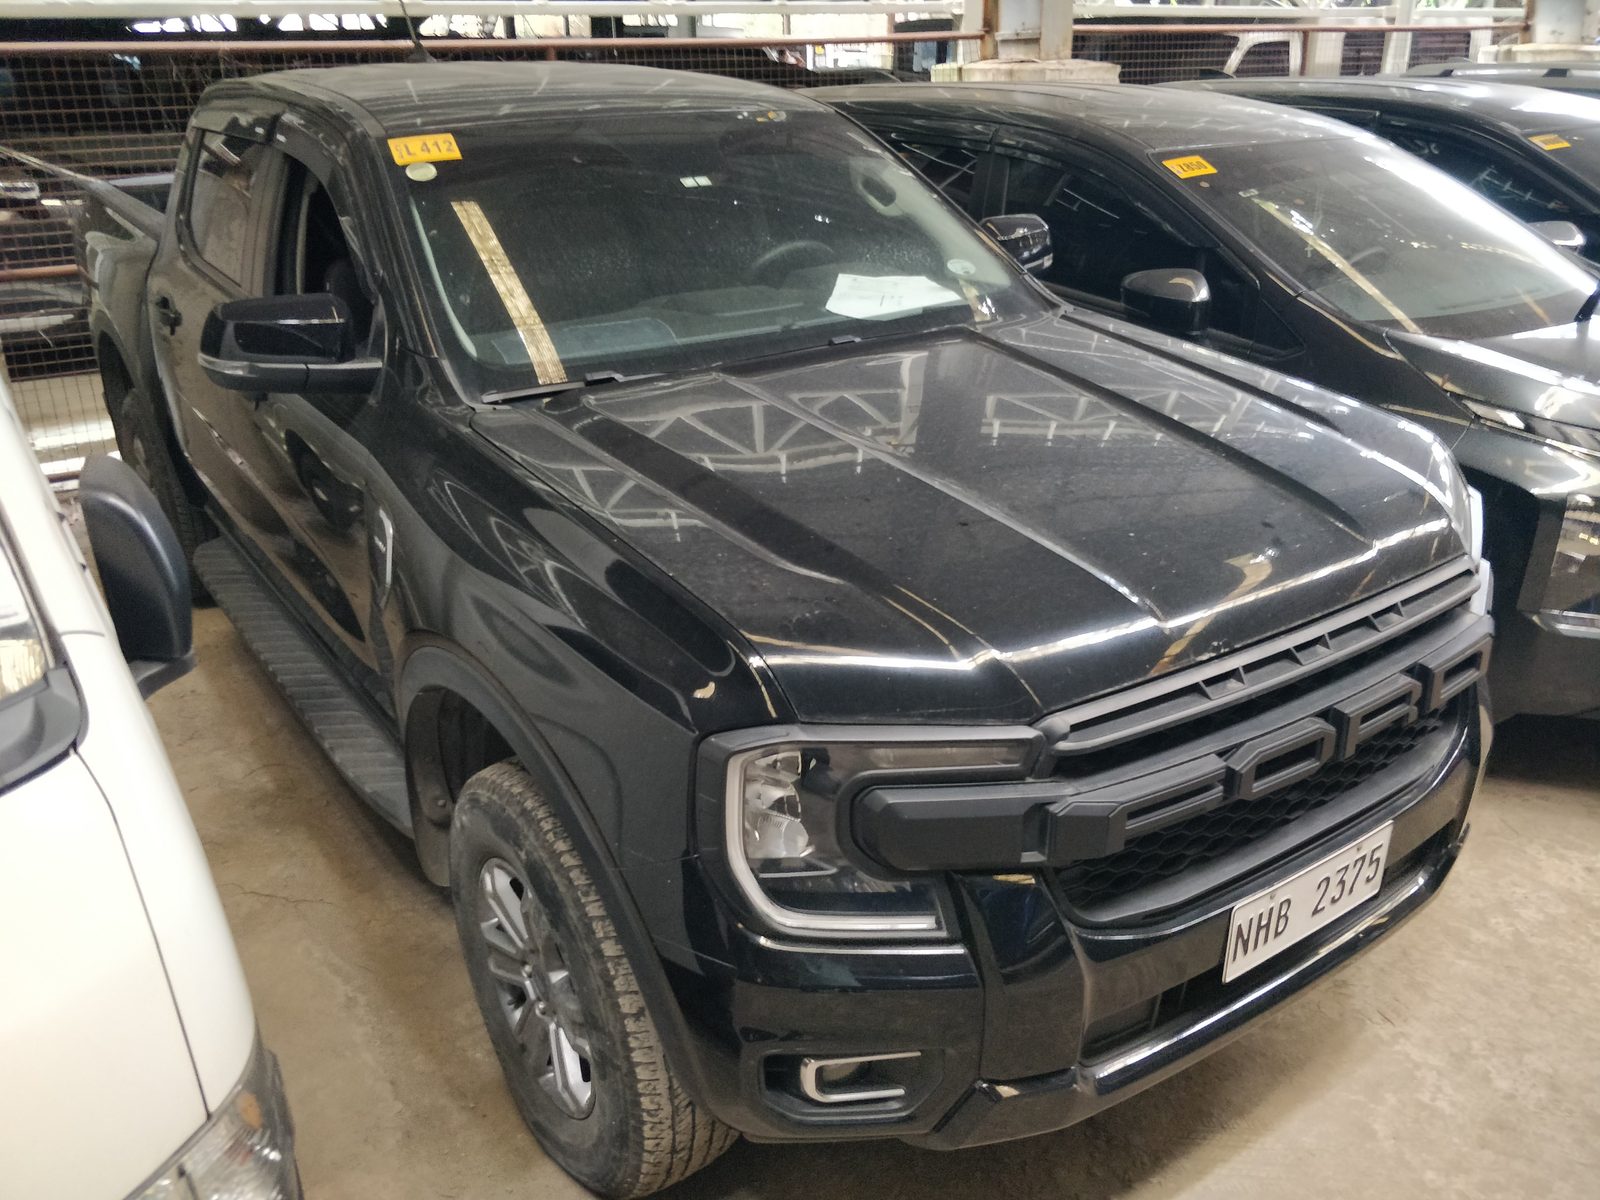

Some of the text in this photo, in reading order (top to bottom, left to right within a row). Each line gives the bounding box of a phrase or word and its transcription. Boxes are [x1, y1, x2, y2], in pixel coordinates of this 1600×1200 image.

[420, 140, 456, 154] 412
[1232, 842, 1384, 963] NHB 2375
